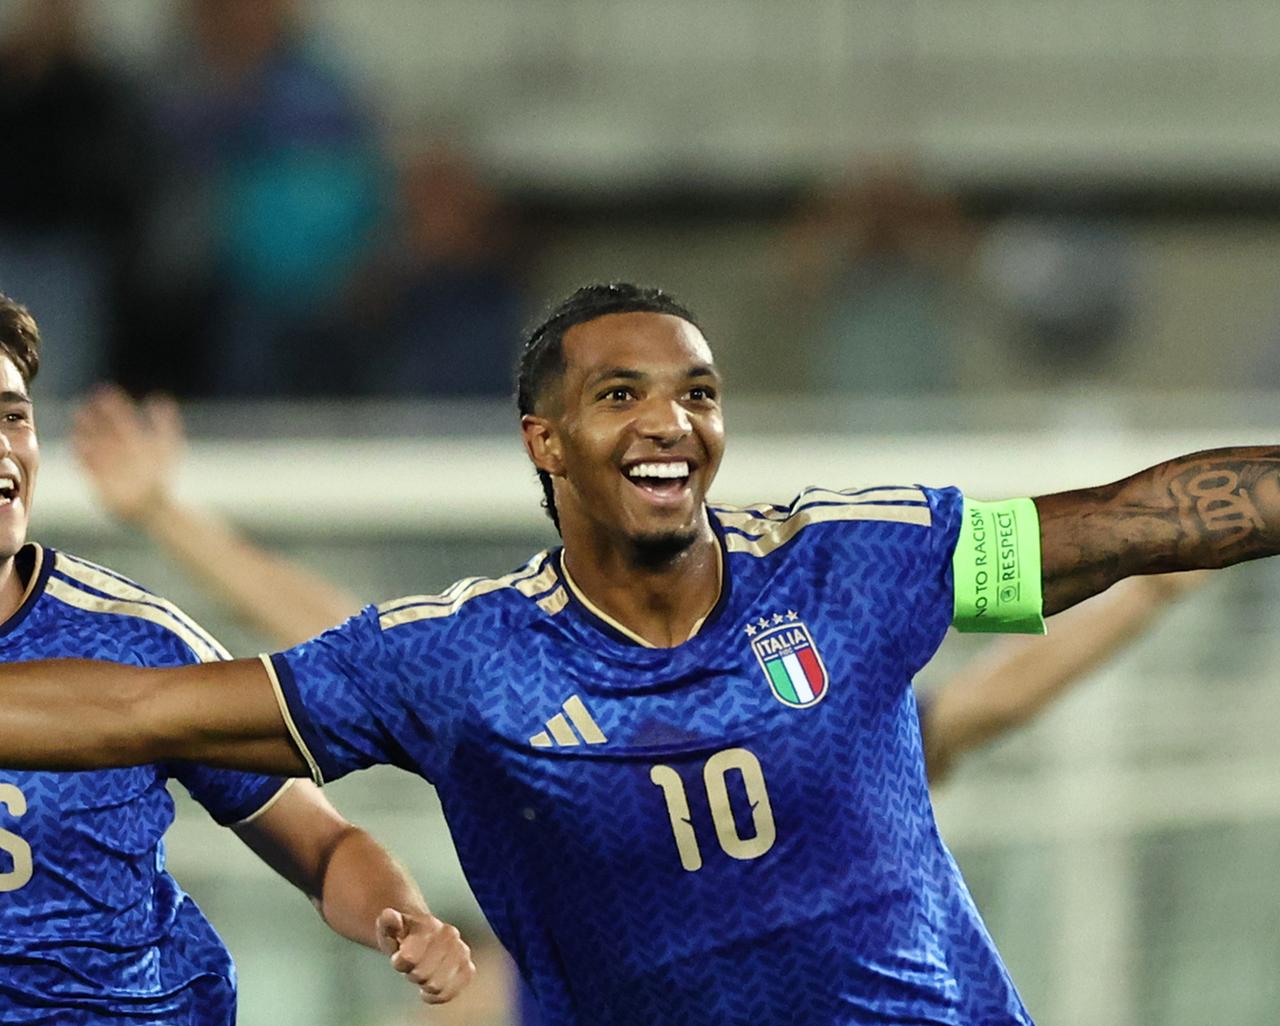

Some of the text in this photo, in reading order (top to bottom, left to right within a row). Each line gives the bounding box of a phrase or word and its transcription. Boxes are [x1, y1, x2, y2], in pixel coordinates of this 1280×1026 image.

[970, 508, 988, 618] NO TO RACISM
[997, 511, 1016, 581] RESPECT
[756, 628, 807, 657] ITALIA
[650, 747, 776, 872] 10
